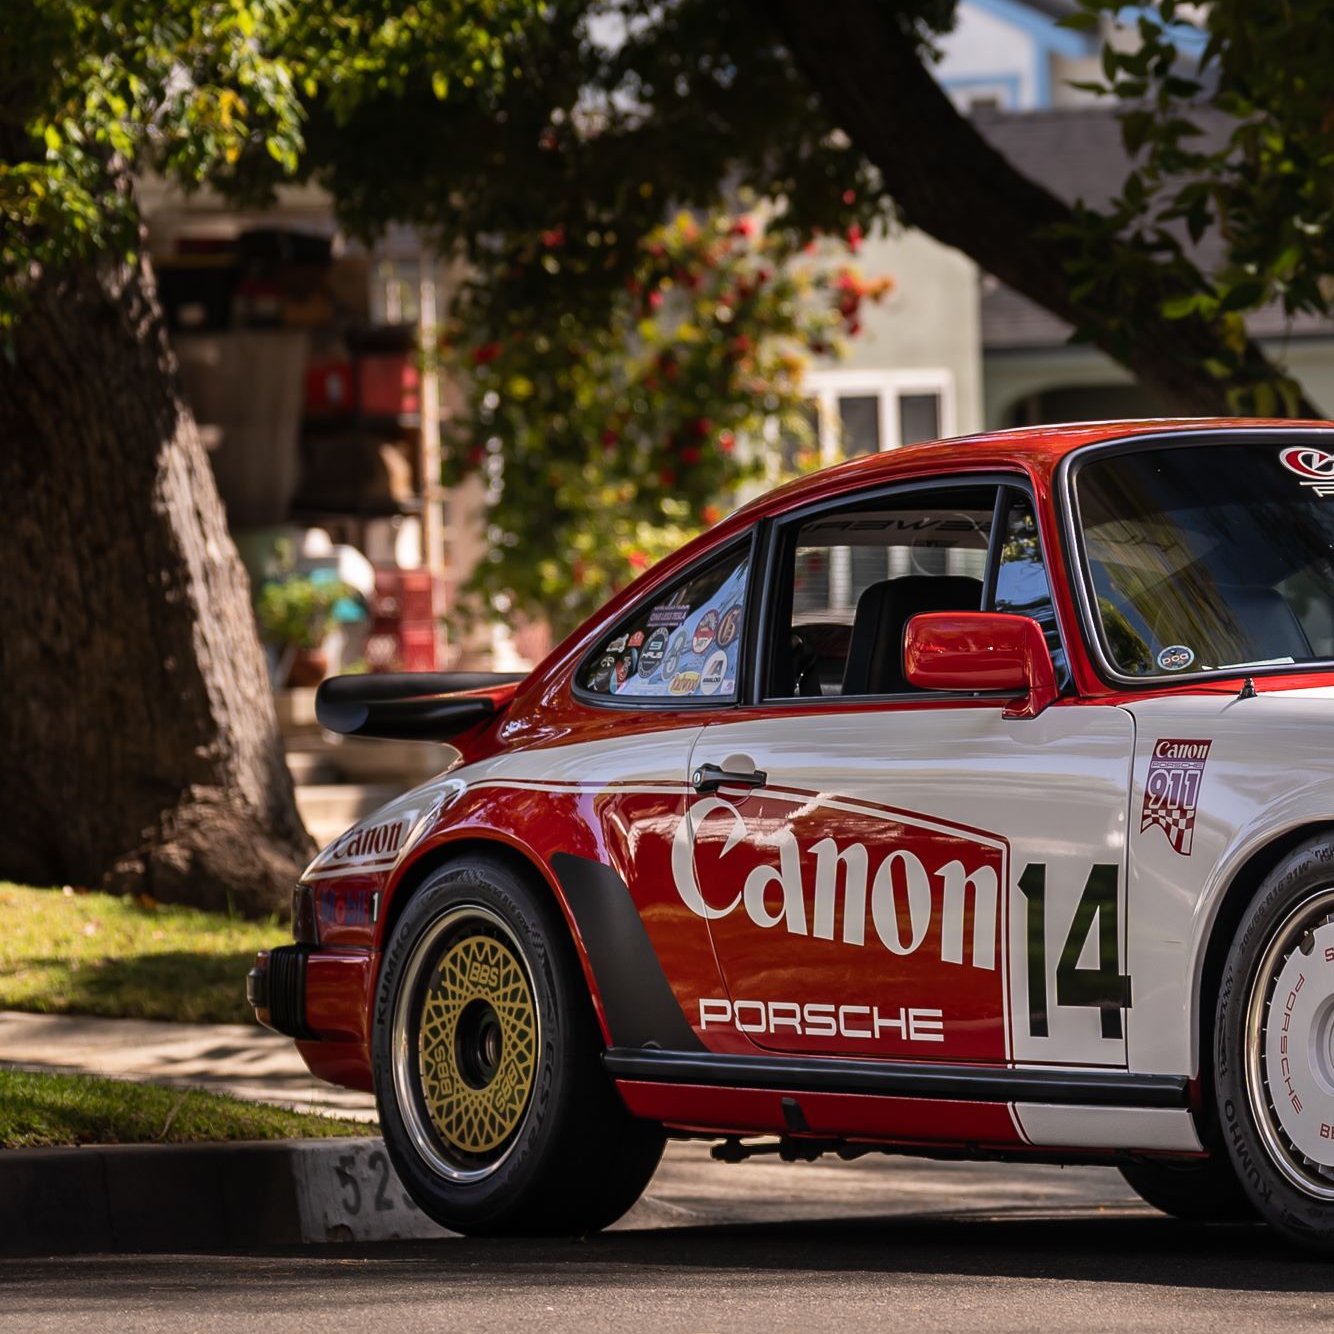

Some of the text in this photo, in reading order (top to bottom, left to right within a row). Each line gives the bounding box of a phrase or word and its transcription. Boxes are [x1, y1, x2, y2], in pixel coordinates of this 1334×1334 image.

[1150, 760, 1205, 769] PORSCHE
[1155, 741, 1209, 759] Canon
[1147, 768, 1202, 810] 911
[332, 821, 403, 860] Canon
[671, 796, 999, 972] Canon
[376, 921, 411, 1027] KUMHO
[468, 960, 501, 988] BBS
[1016, 862, 1133, 1040] 14
[698, 998, 945, 1043] PORSCHE
[1279, 972, 1306, 1115] PORSCHE
[433, 1045, 455, 1097] BBS
[494, 1064, 520, 1114] BBS
[1223, 1099, 1273, 1202] KUMHO
[333, 1150, 419, 1216] 52
